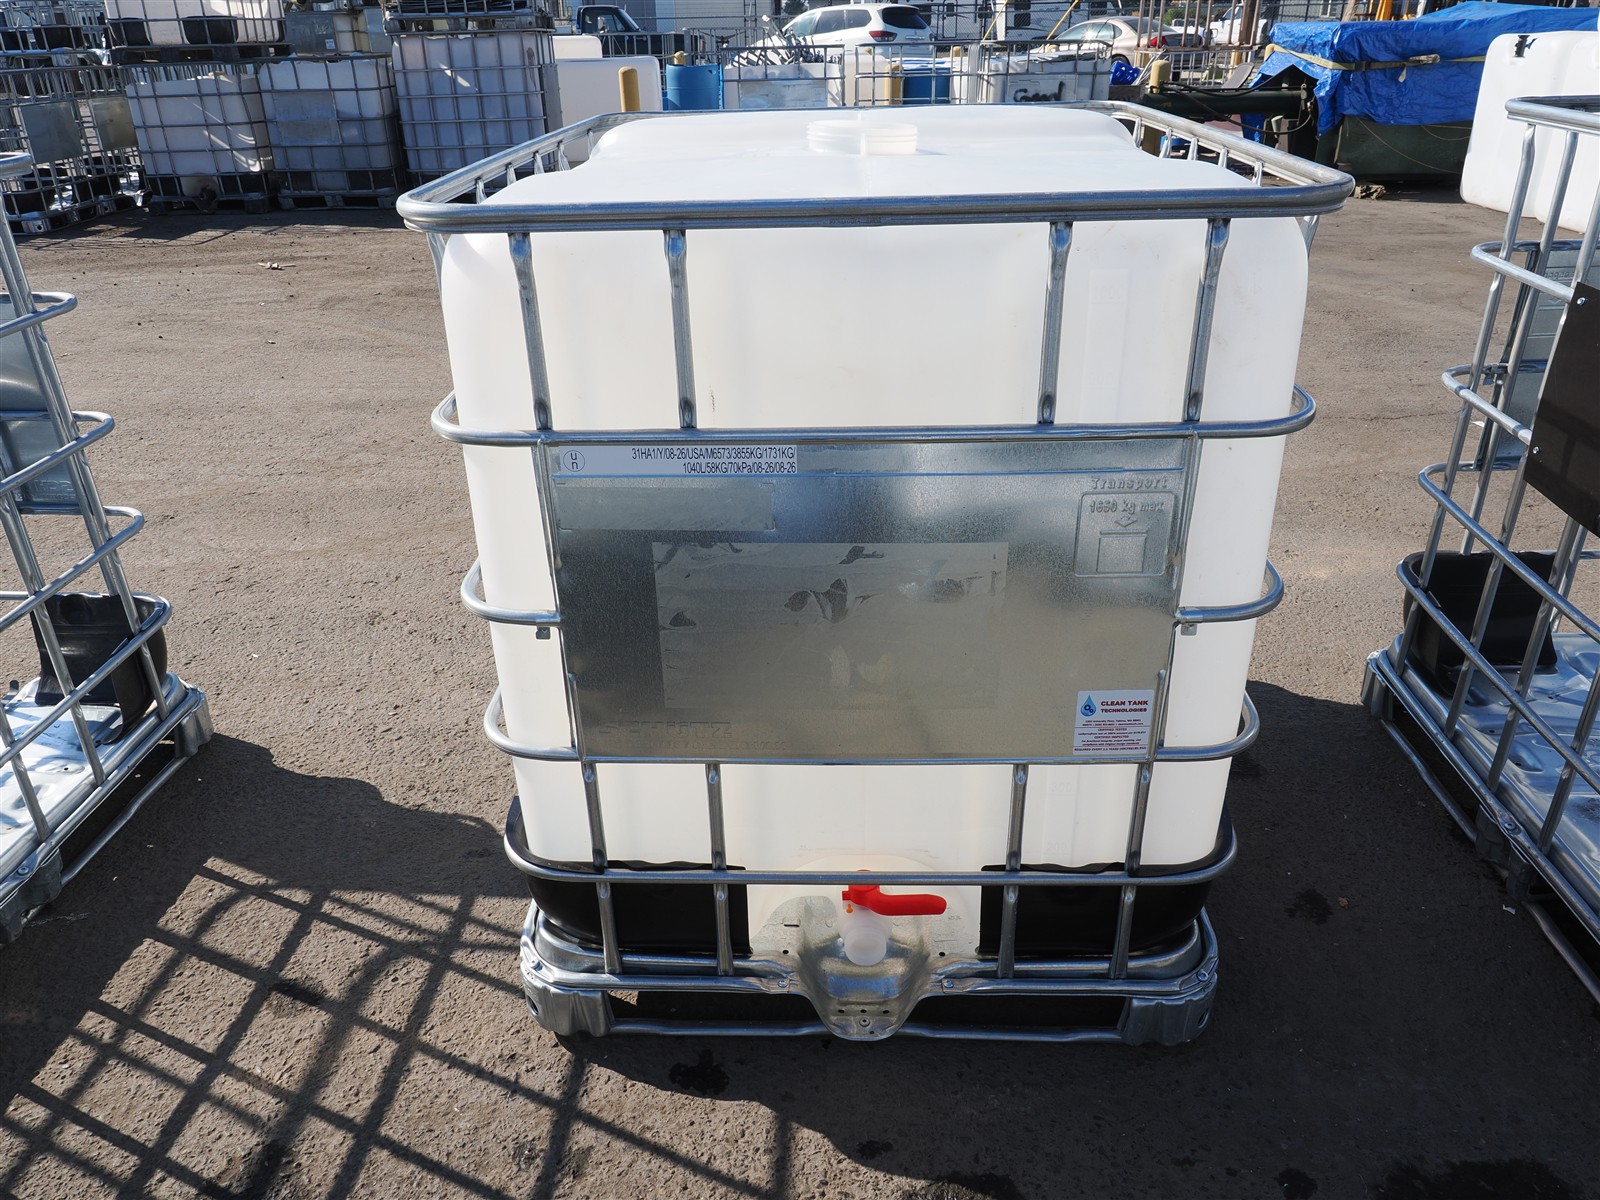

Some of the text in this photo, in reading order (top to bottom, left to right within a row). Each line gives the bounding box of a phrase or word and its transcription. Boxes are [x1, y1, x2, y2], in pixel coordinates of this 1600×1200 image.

[682, 461, 796, 474] 1040L/58KG/70kPa/08-26/08-26
[1091, 476, 1168, 491] Transport
[1121, 499, 1136, 515] kg
[1140, 501, 1165, 513] max
